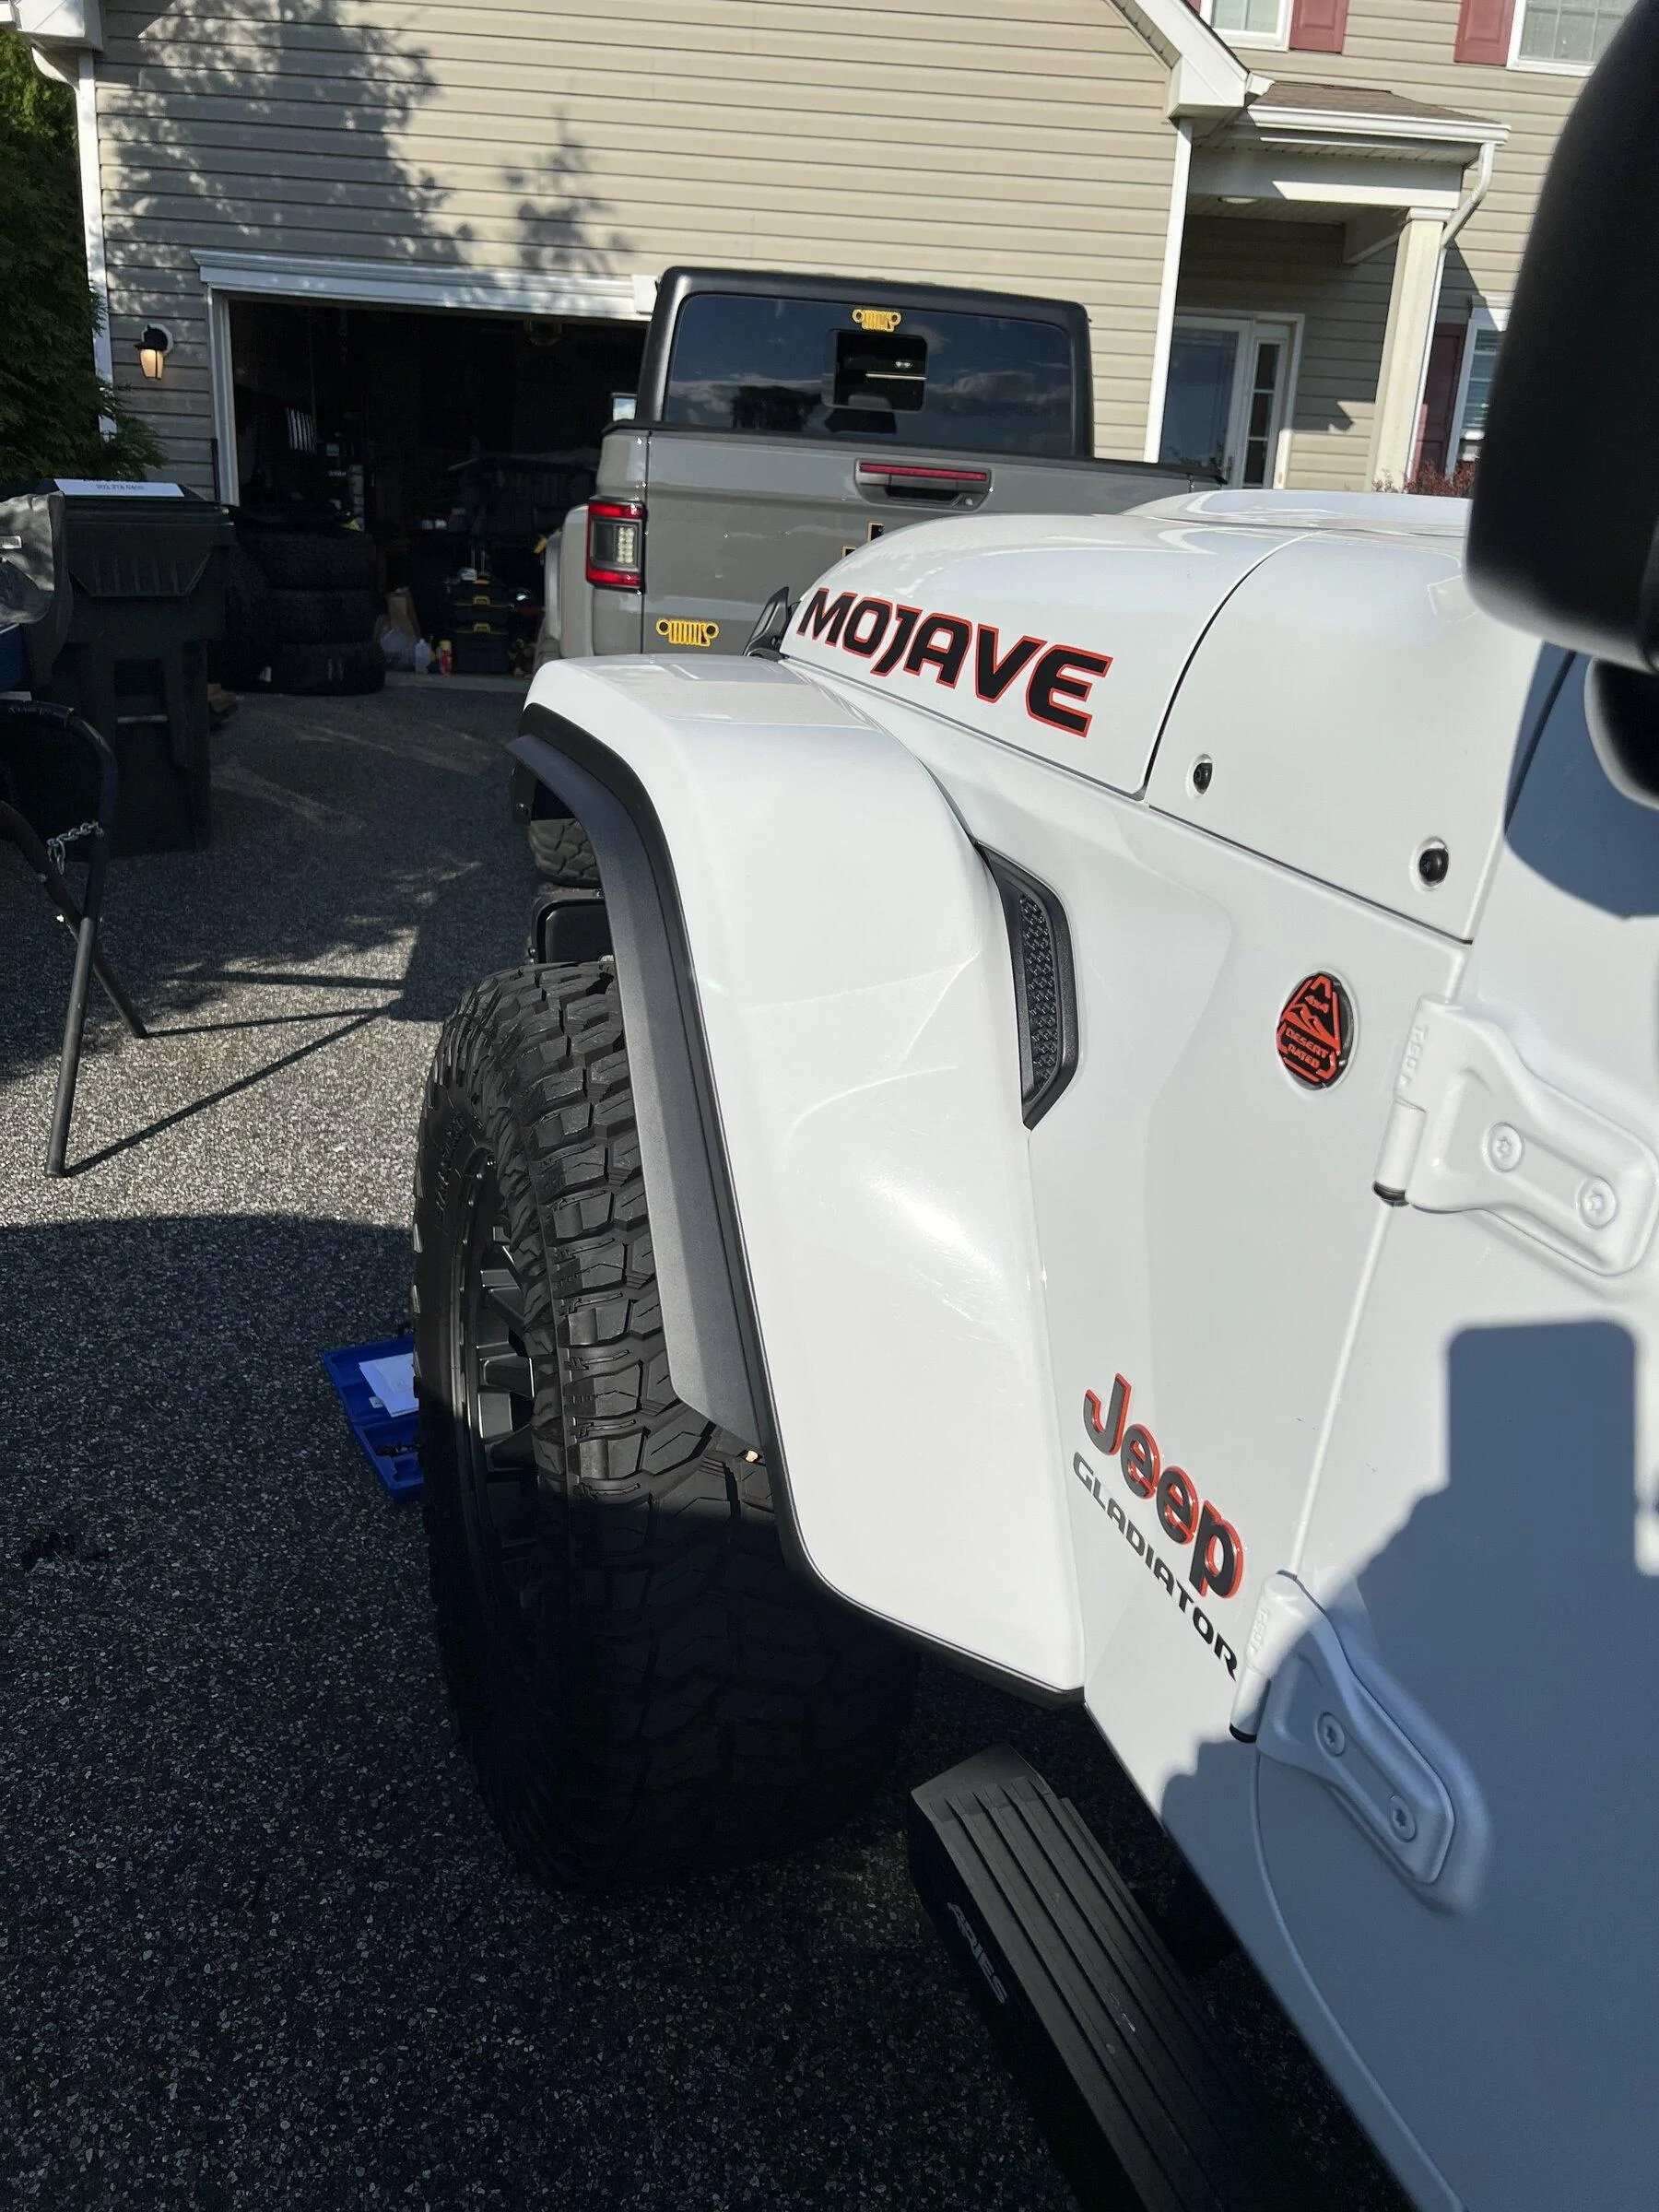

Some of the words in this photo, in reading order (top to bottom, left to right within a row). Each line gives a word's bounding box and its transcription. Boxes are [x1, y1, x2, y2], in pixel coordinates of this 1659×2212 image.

[796, 587, 1113, 738] MOJAVE
[1285, 1028, 1330, 1058] DESERT
[1287, 1043, 1321, 1069] RATED
[1083, 1372, 1244, 1599] Jeep
[1073, 1452, 1238, 1682] GLADIATOR
[947, 1901, 1008, 2004] ARIES
